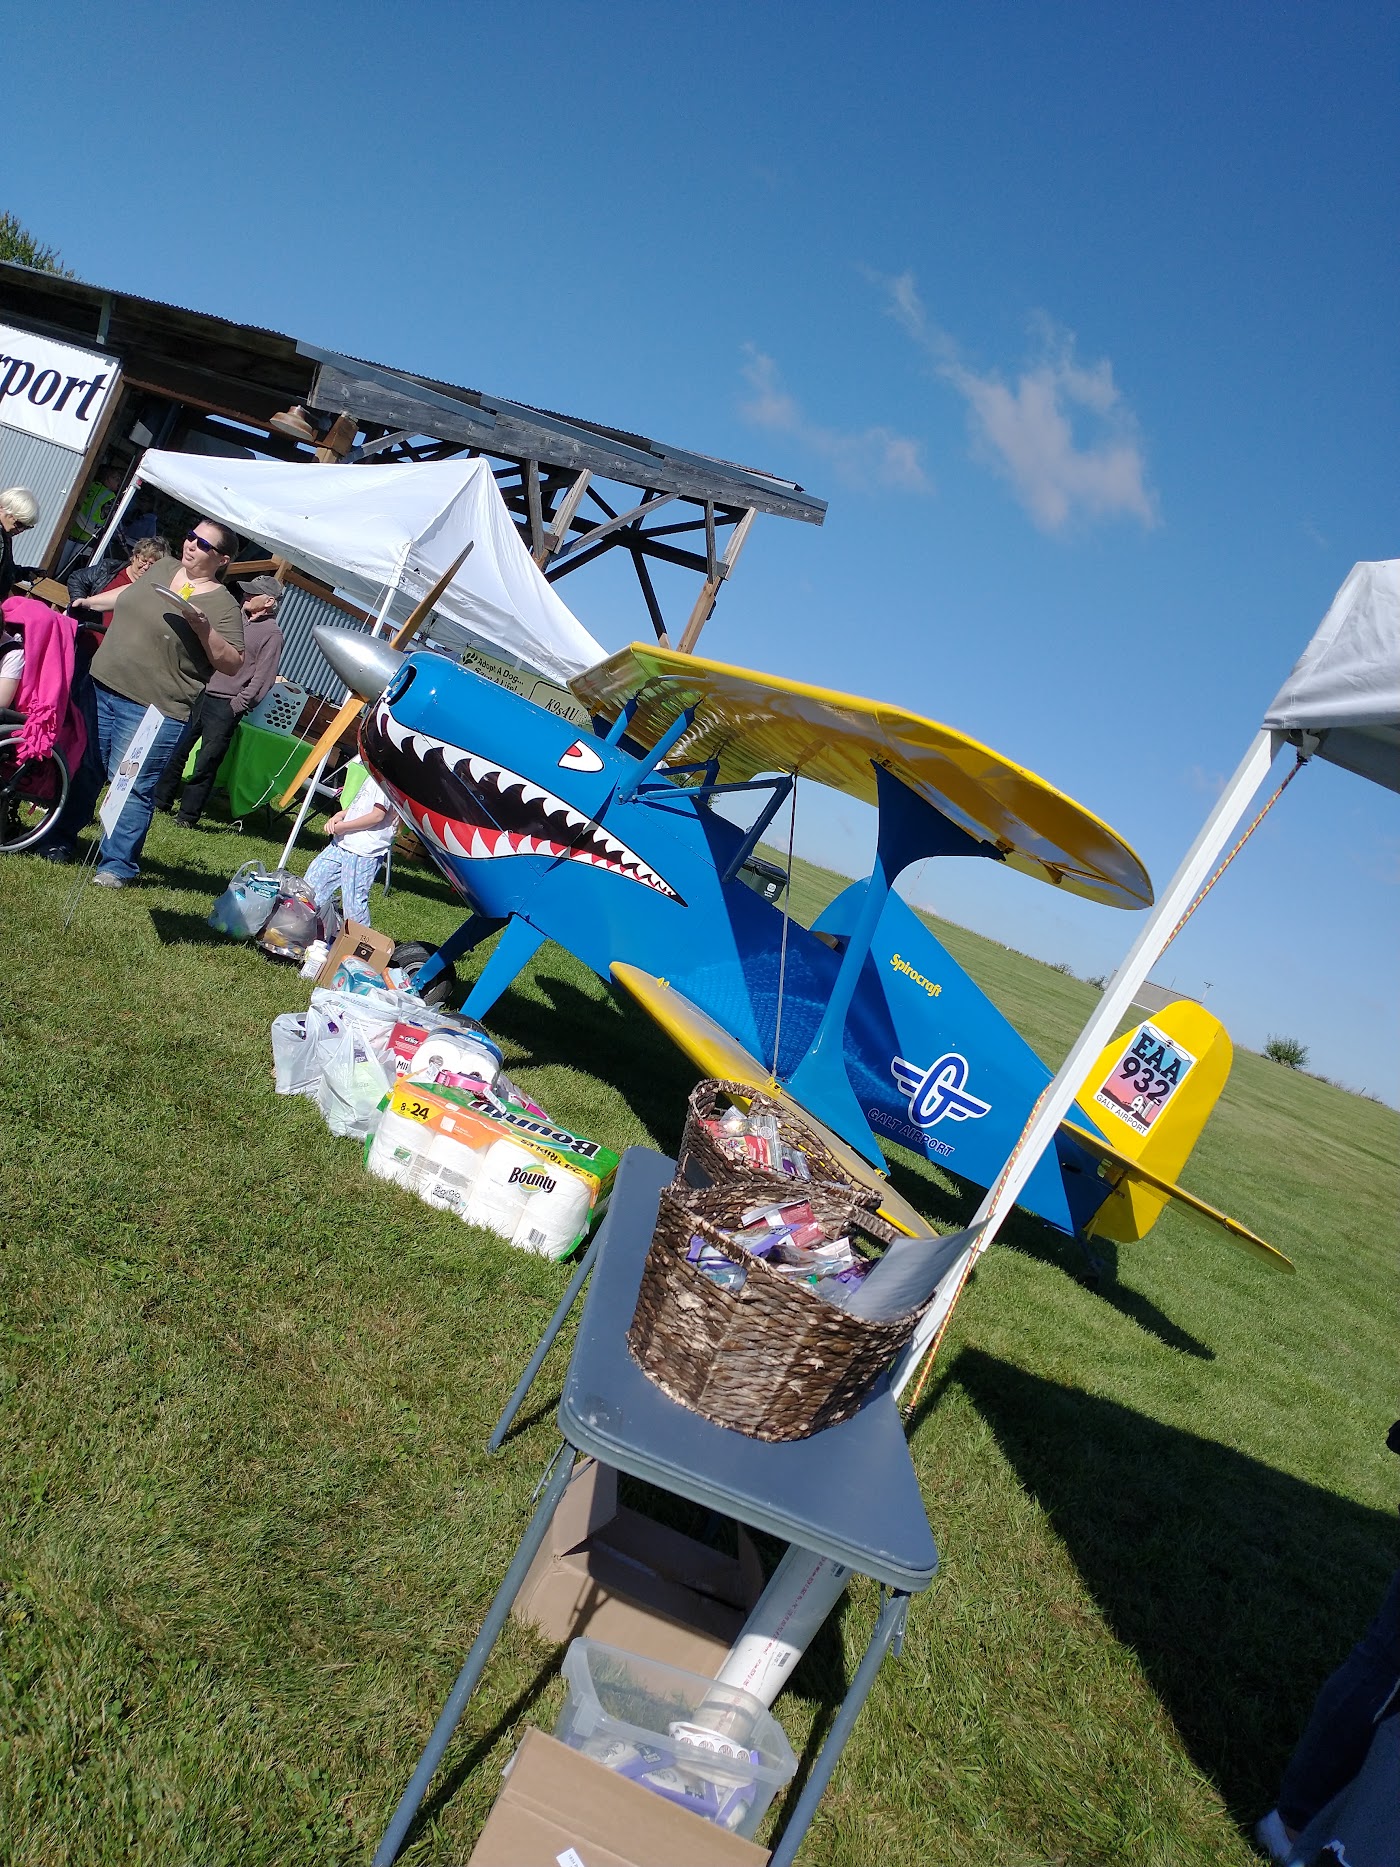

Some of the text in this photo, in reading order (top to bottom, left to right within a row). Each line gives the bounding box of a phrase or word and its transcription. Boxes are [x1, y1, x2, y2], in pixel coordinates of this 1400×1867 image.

[477, 658, 496, 673] Adopt
[497, 667, 502, 676] A
[890, 953, 942, 997] Spirocraft
[1119, 1056, 1170, 1106] 932
[1131, 1032, 1182, 1086] EAA
[410, 1102, 430, 1120] 24
[467, 1100, 601, 1161] Bounty
[868, 1107, 955, 1157] GALT AIRPORT
[1096, 1094, 1147, 1134] GALT AIRPORT
[508, 1166, 557, 1194] Bounty
